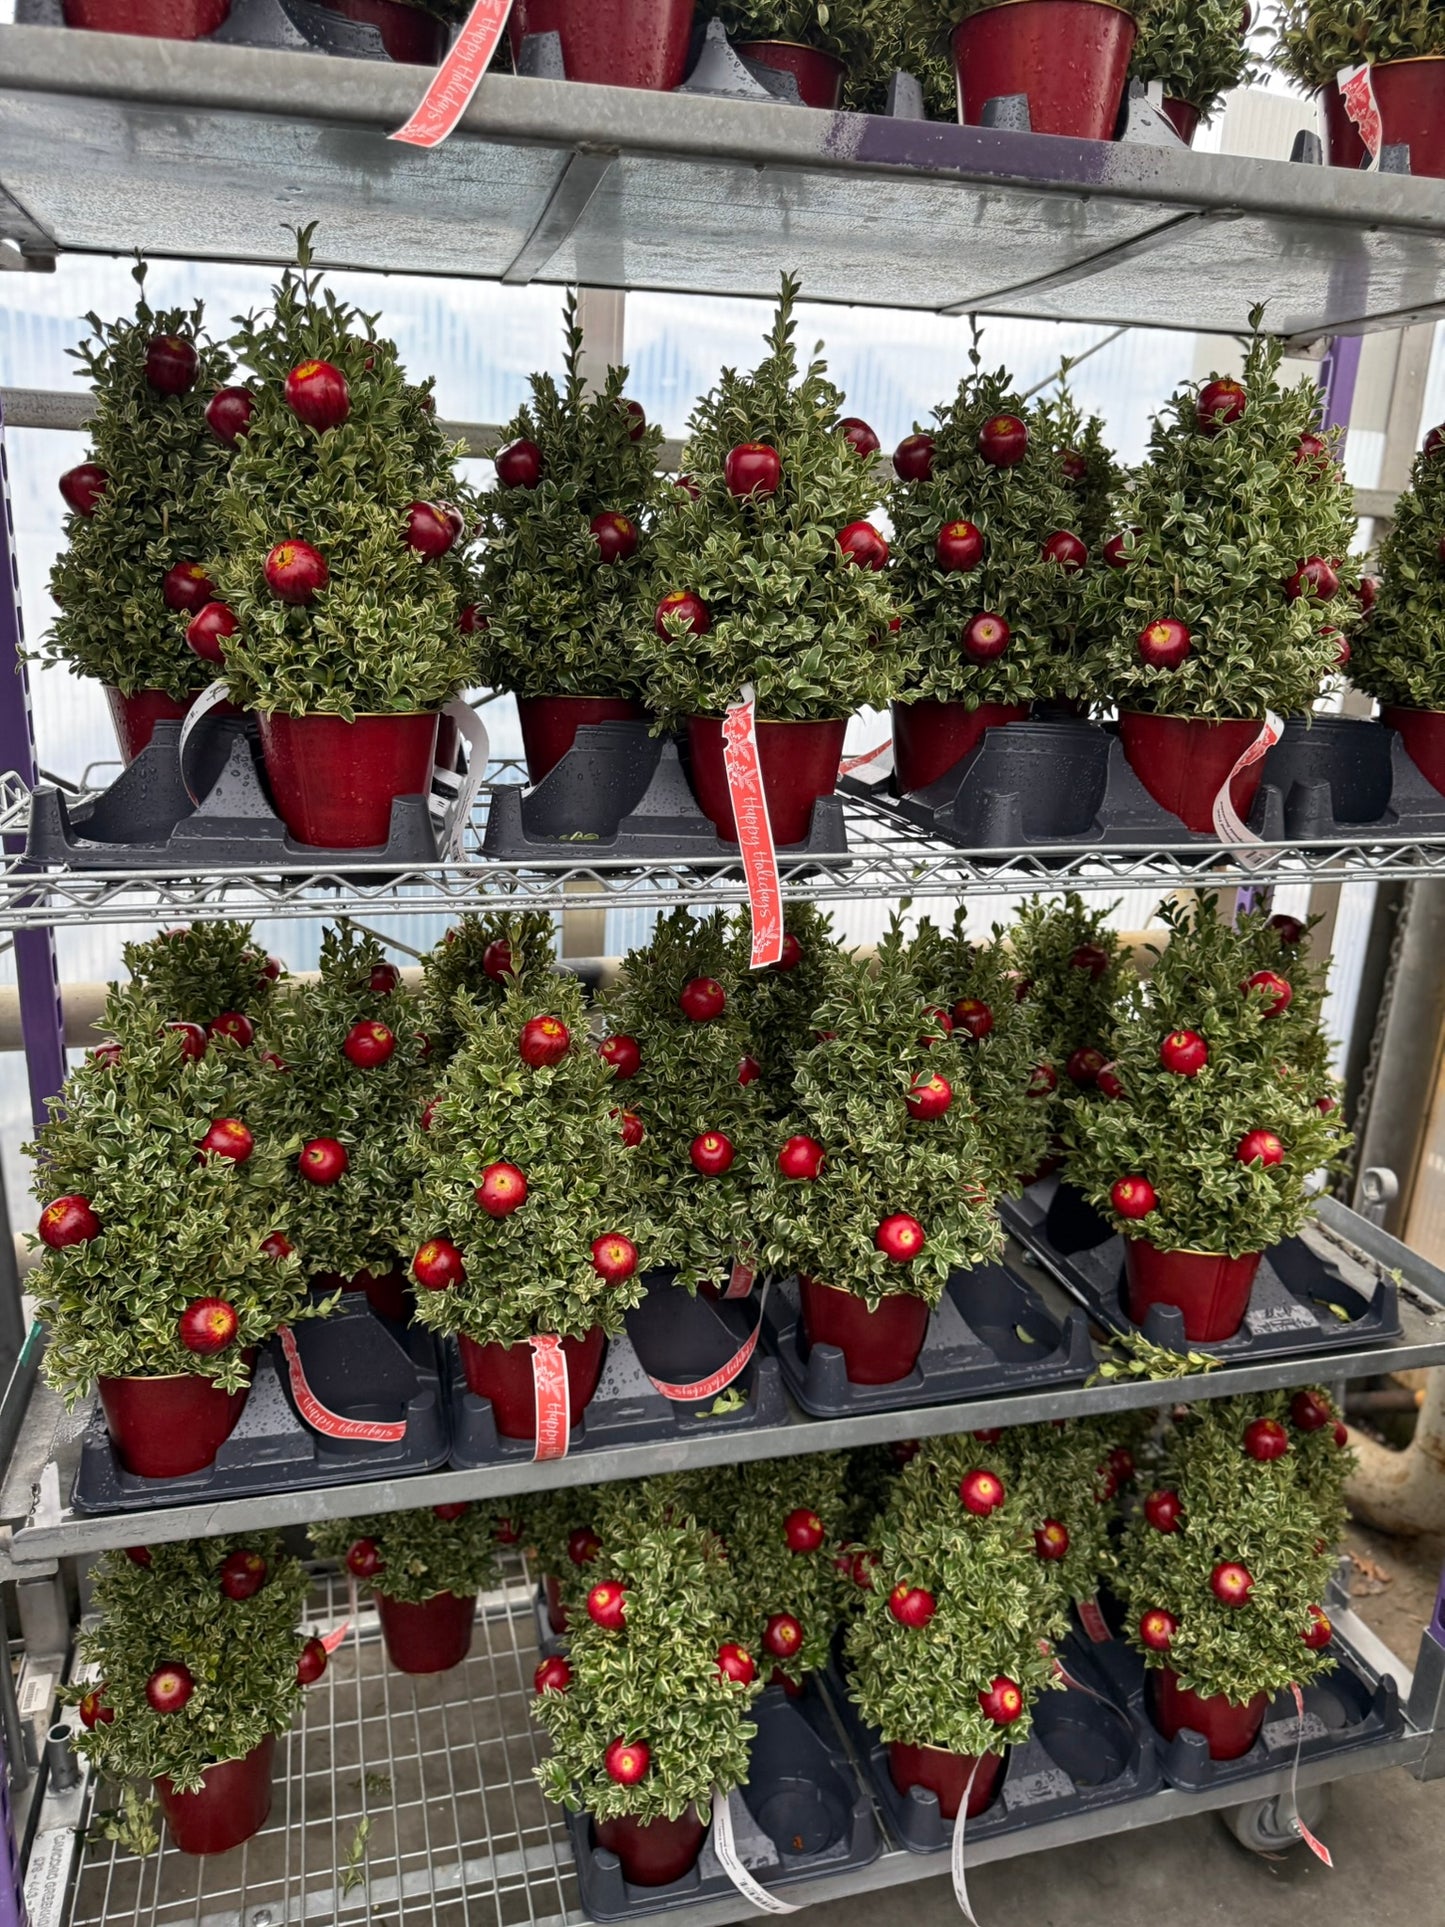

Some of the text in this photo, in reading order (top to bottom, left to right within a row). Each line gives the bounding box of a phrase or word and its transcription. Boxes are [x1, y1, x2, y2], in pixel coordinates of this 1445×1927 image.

[425, 17, 498, 121] Happy Holidays
[739, 797, 776, 918] Happy Holidays
[303, 1396, 394, 1437] Happy Holidays
[539, 1402, 566, 1445] Happy
